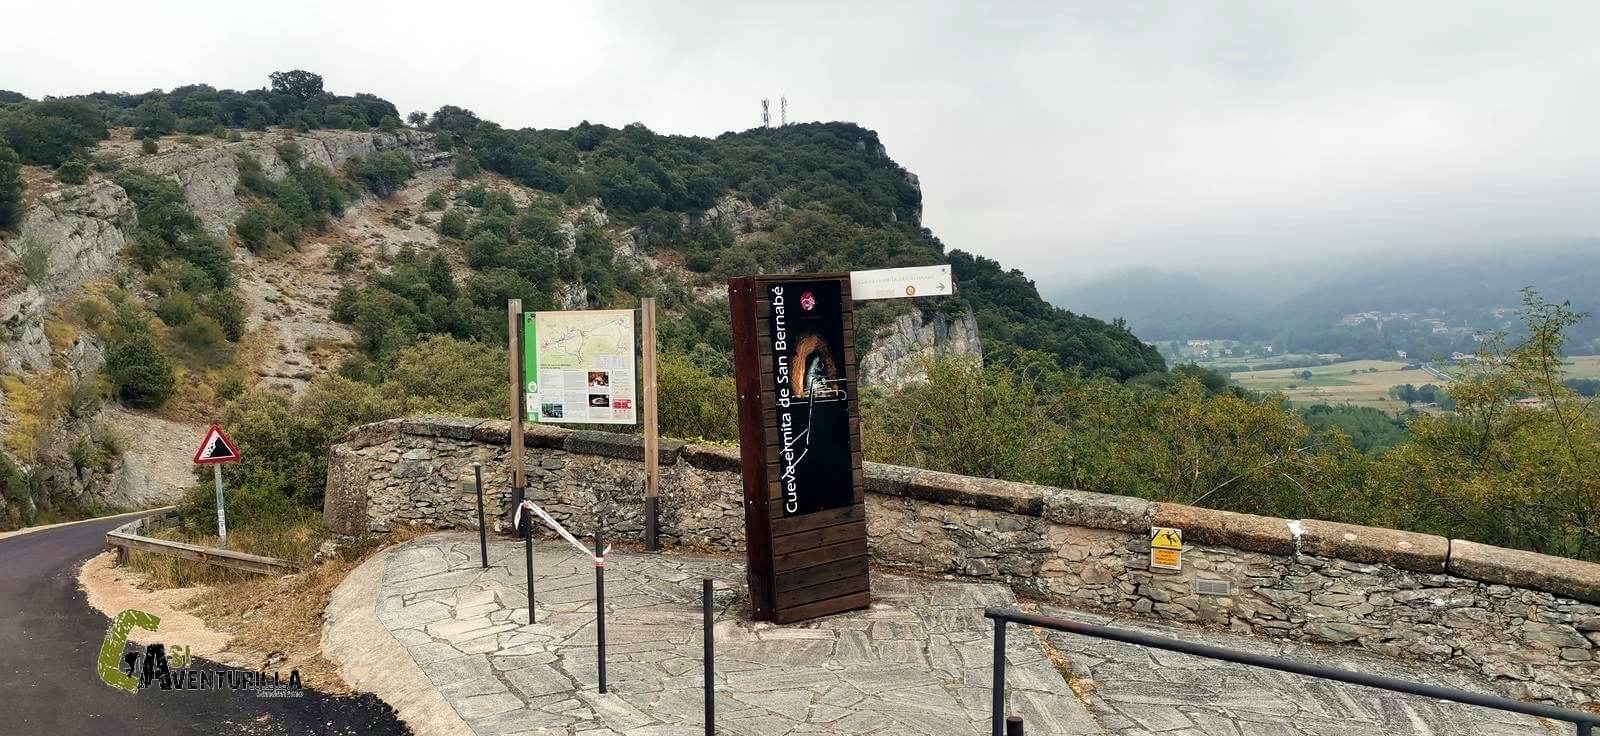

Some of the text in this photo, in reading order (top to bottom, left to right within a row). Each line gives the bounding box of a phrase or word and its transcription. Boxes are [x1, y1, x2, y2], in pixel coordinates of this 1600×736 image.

[772, 286, 798, 513] Cueva-ermita de San Bernabé
